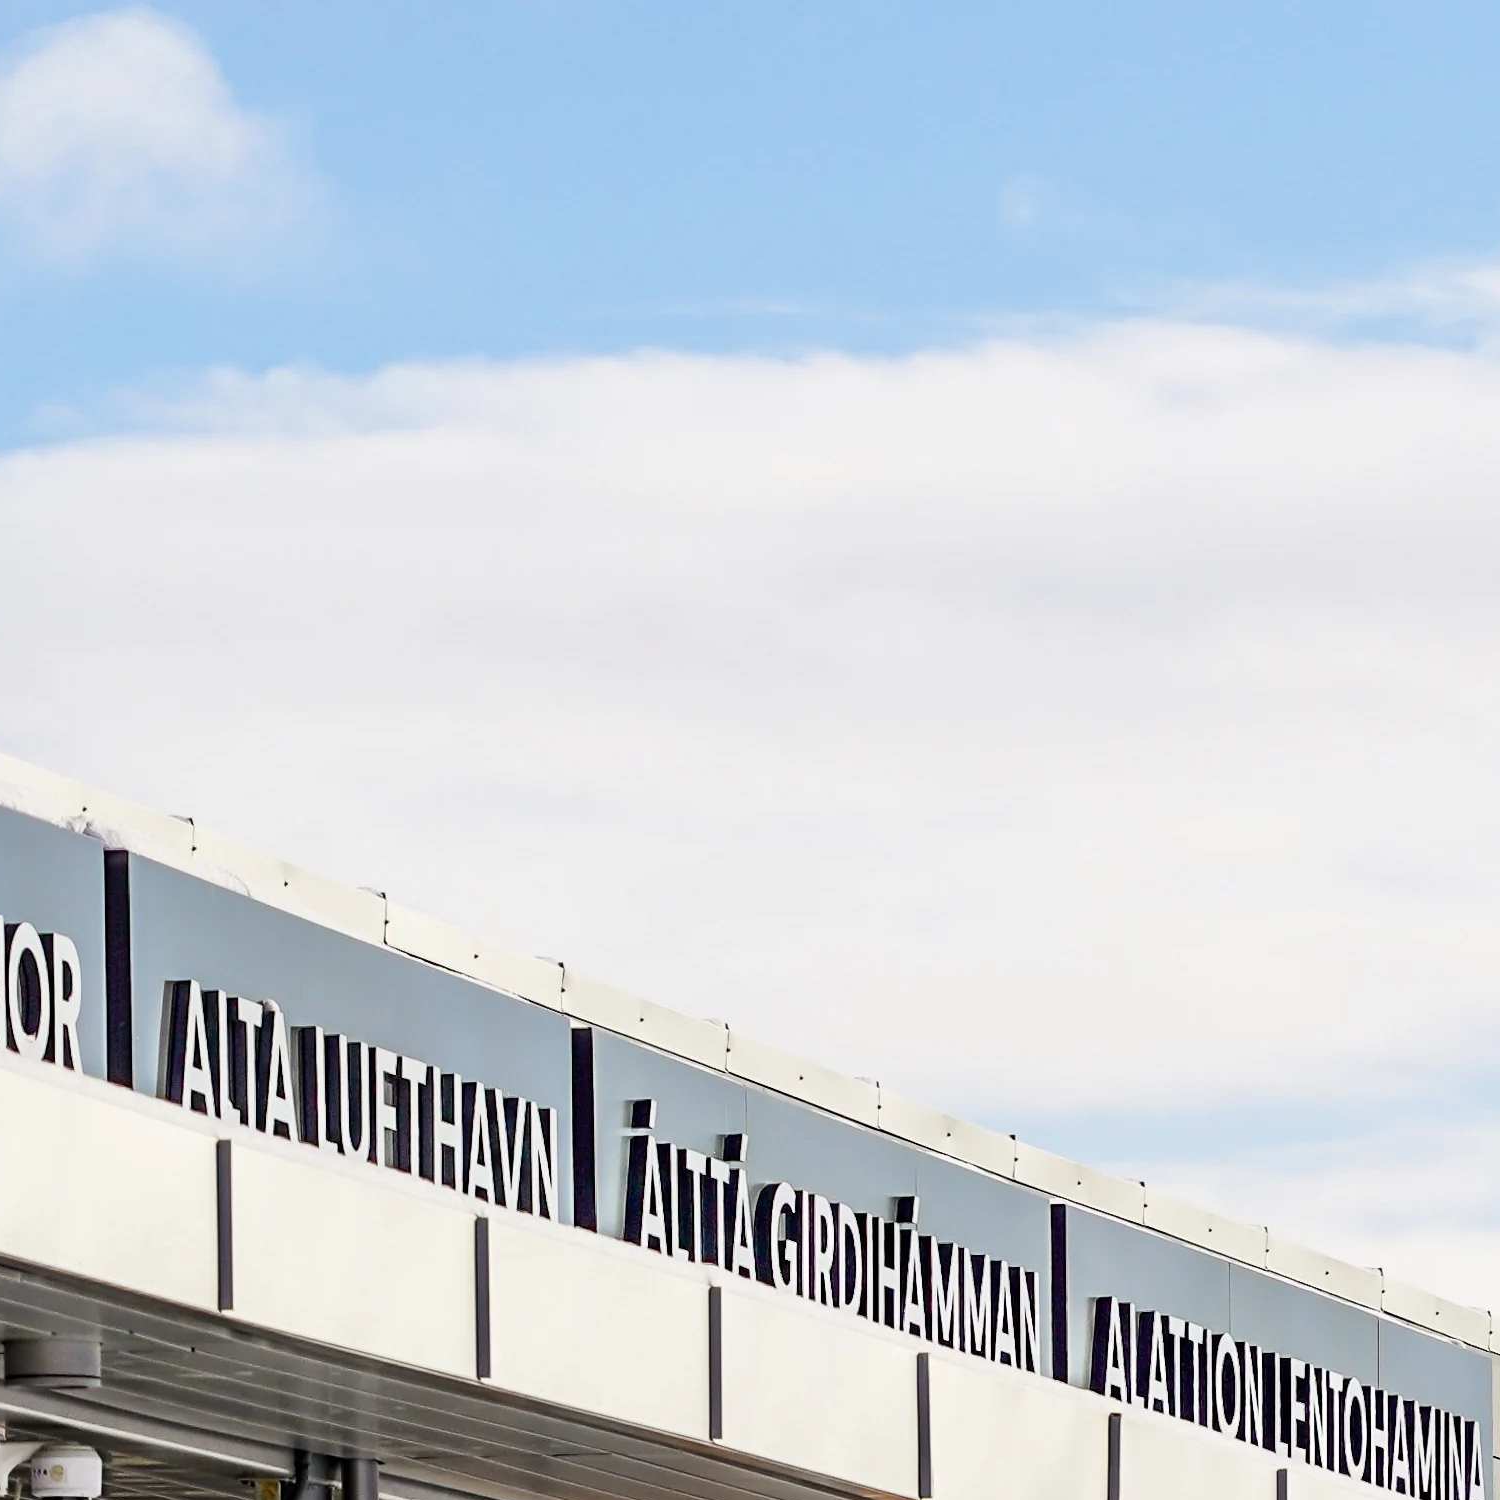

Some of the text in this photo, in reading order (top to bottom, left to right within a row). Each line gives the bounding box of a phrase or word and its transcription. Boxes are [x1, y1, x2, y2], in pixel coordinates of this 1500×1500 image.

[170, 979, 561, 1225] ALTA LUFTHAVN
[1096, 1296, 1264, 1447] ALATTION
